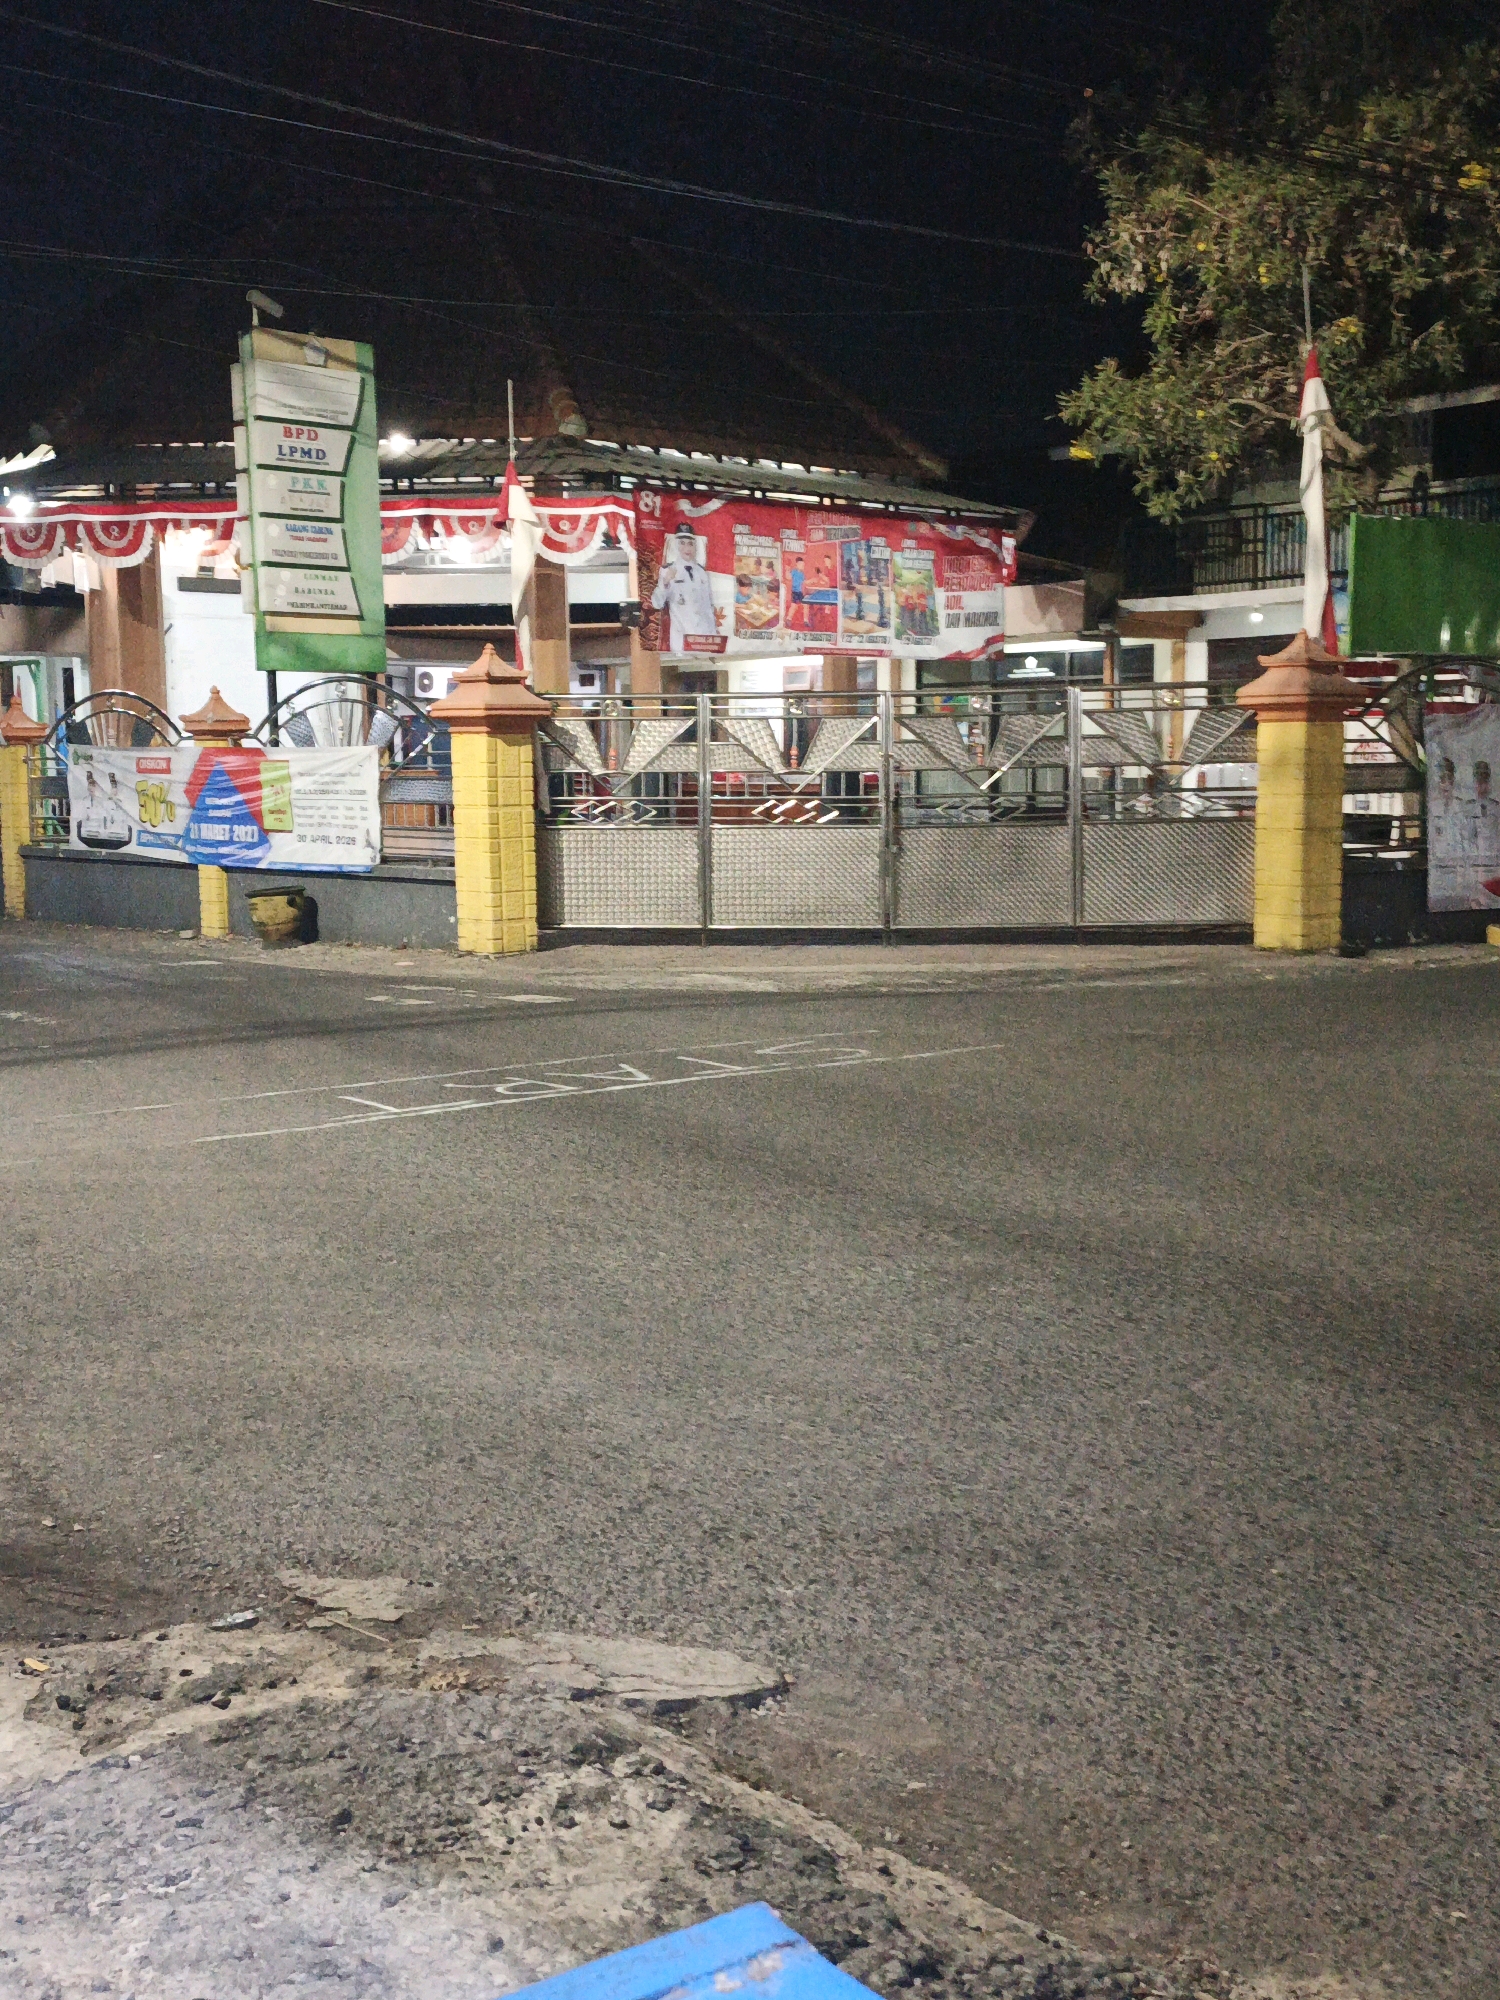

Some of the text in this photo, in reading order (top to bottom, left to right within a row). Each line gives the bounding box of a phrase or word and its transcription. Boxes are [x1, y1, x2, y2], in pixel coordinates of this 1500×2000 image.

[283, 426, 318, 441] BPD
[277, 445, 326, 460] LPMD
[639, 490, 662, 517] 81
[138, 759, 167, 770] DISKON
[135, 780, 176, 828] 50%
[310, 834, 333, 845] APRIL
